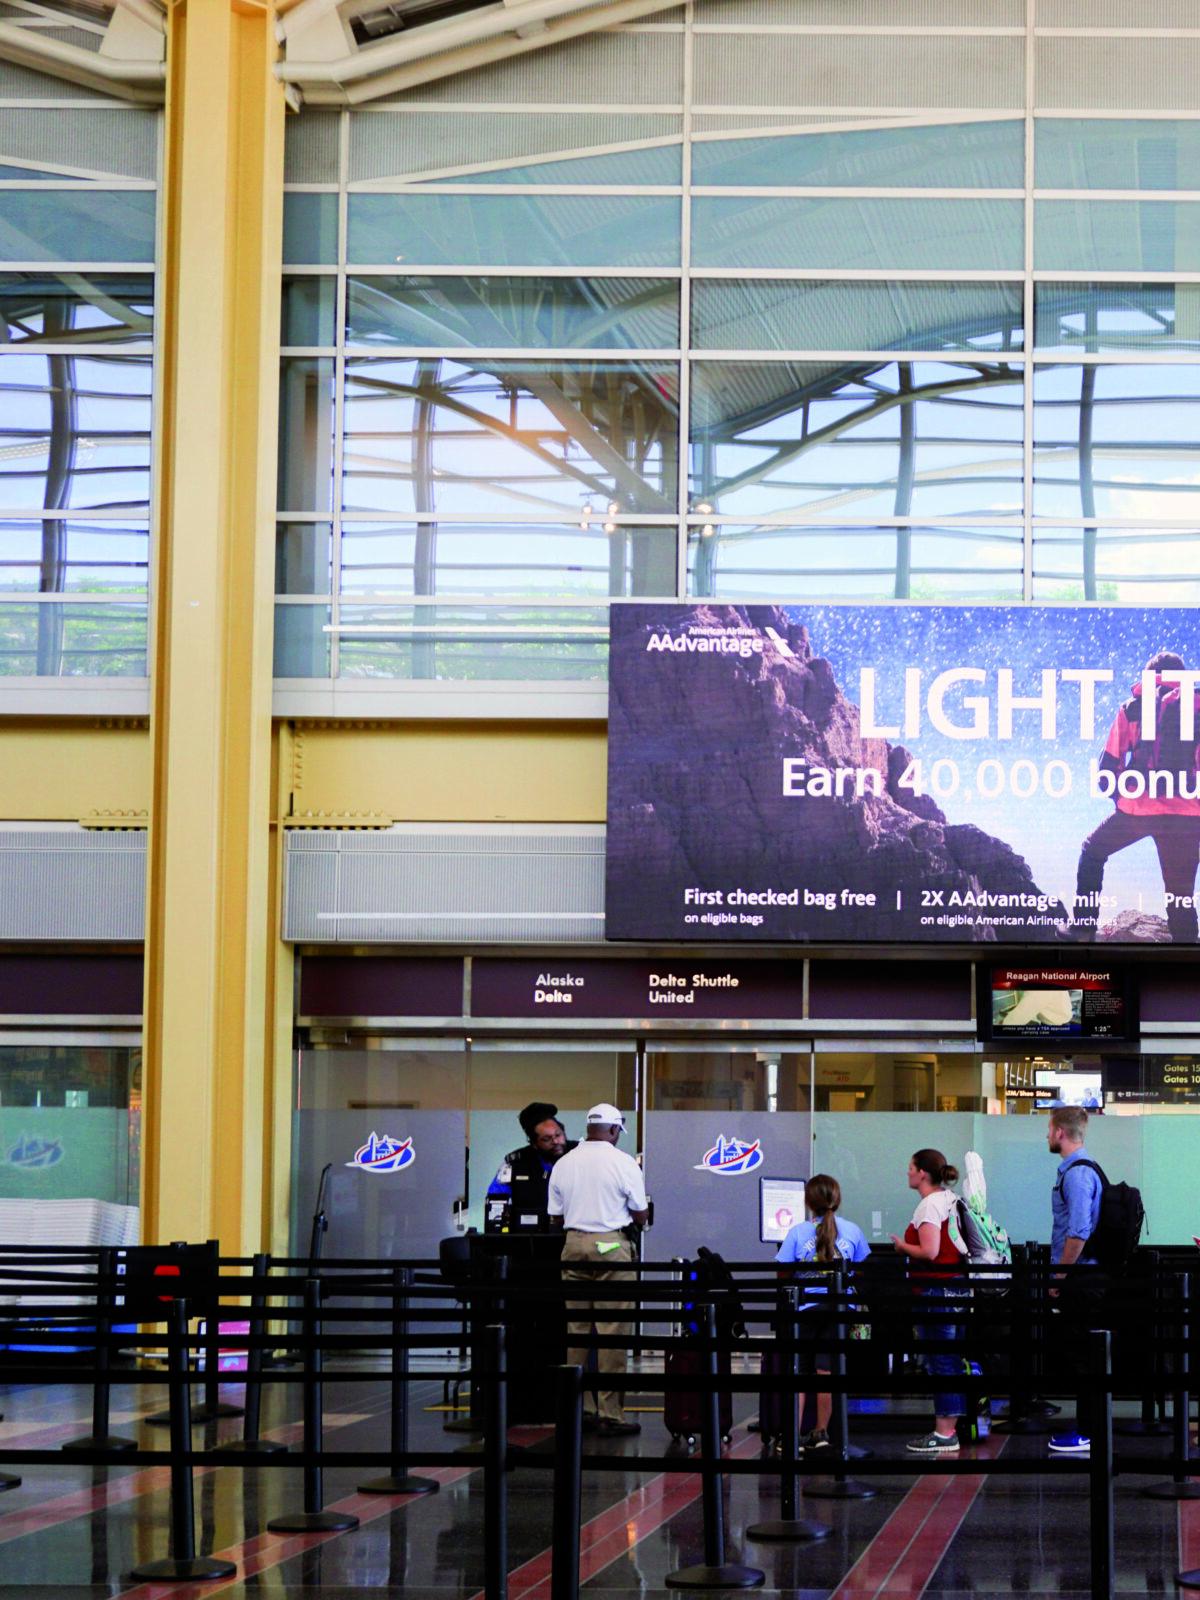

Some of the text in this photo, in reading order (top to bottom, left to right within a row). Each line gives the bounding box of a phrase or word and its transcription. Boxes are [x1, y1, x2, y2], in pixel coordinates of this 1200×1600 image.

[689, 627, 756, 636] American Airlines
[647, 634, 763, 657] AAdvantage
[860, 668, 1113, 740] LIGHT
[783, 758, 881, 797] Earn
[897, 759, 1072, 803] 40,000
[685, 889, 876, 909] First checked bag free
[921, 891, 942, 906] 2X
[1072, 892, 1117, 907] miles
[685, 913, 763, 926] on eligible bags
[921, 913, 1117, 929] on eligible American Airlines purchases
[536, 974, 584, 987] Alaska
[649, 974, 739, 987] Delta Shuttle
[1006, 972, 1110, 982] Reagan National Airport
[534, 990, 572, 1003] Delta
[649, 991, 694, 1003] United
[1164, 1064, 1188, 1072] Gates
[1164, 1075, 1188, 1083] Gates
